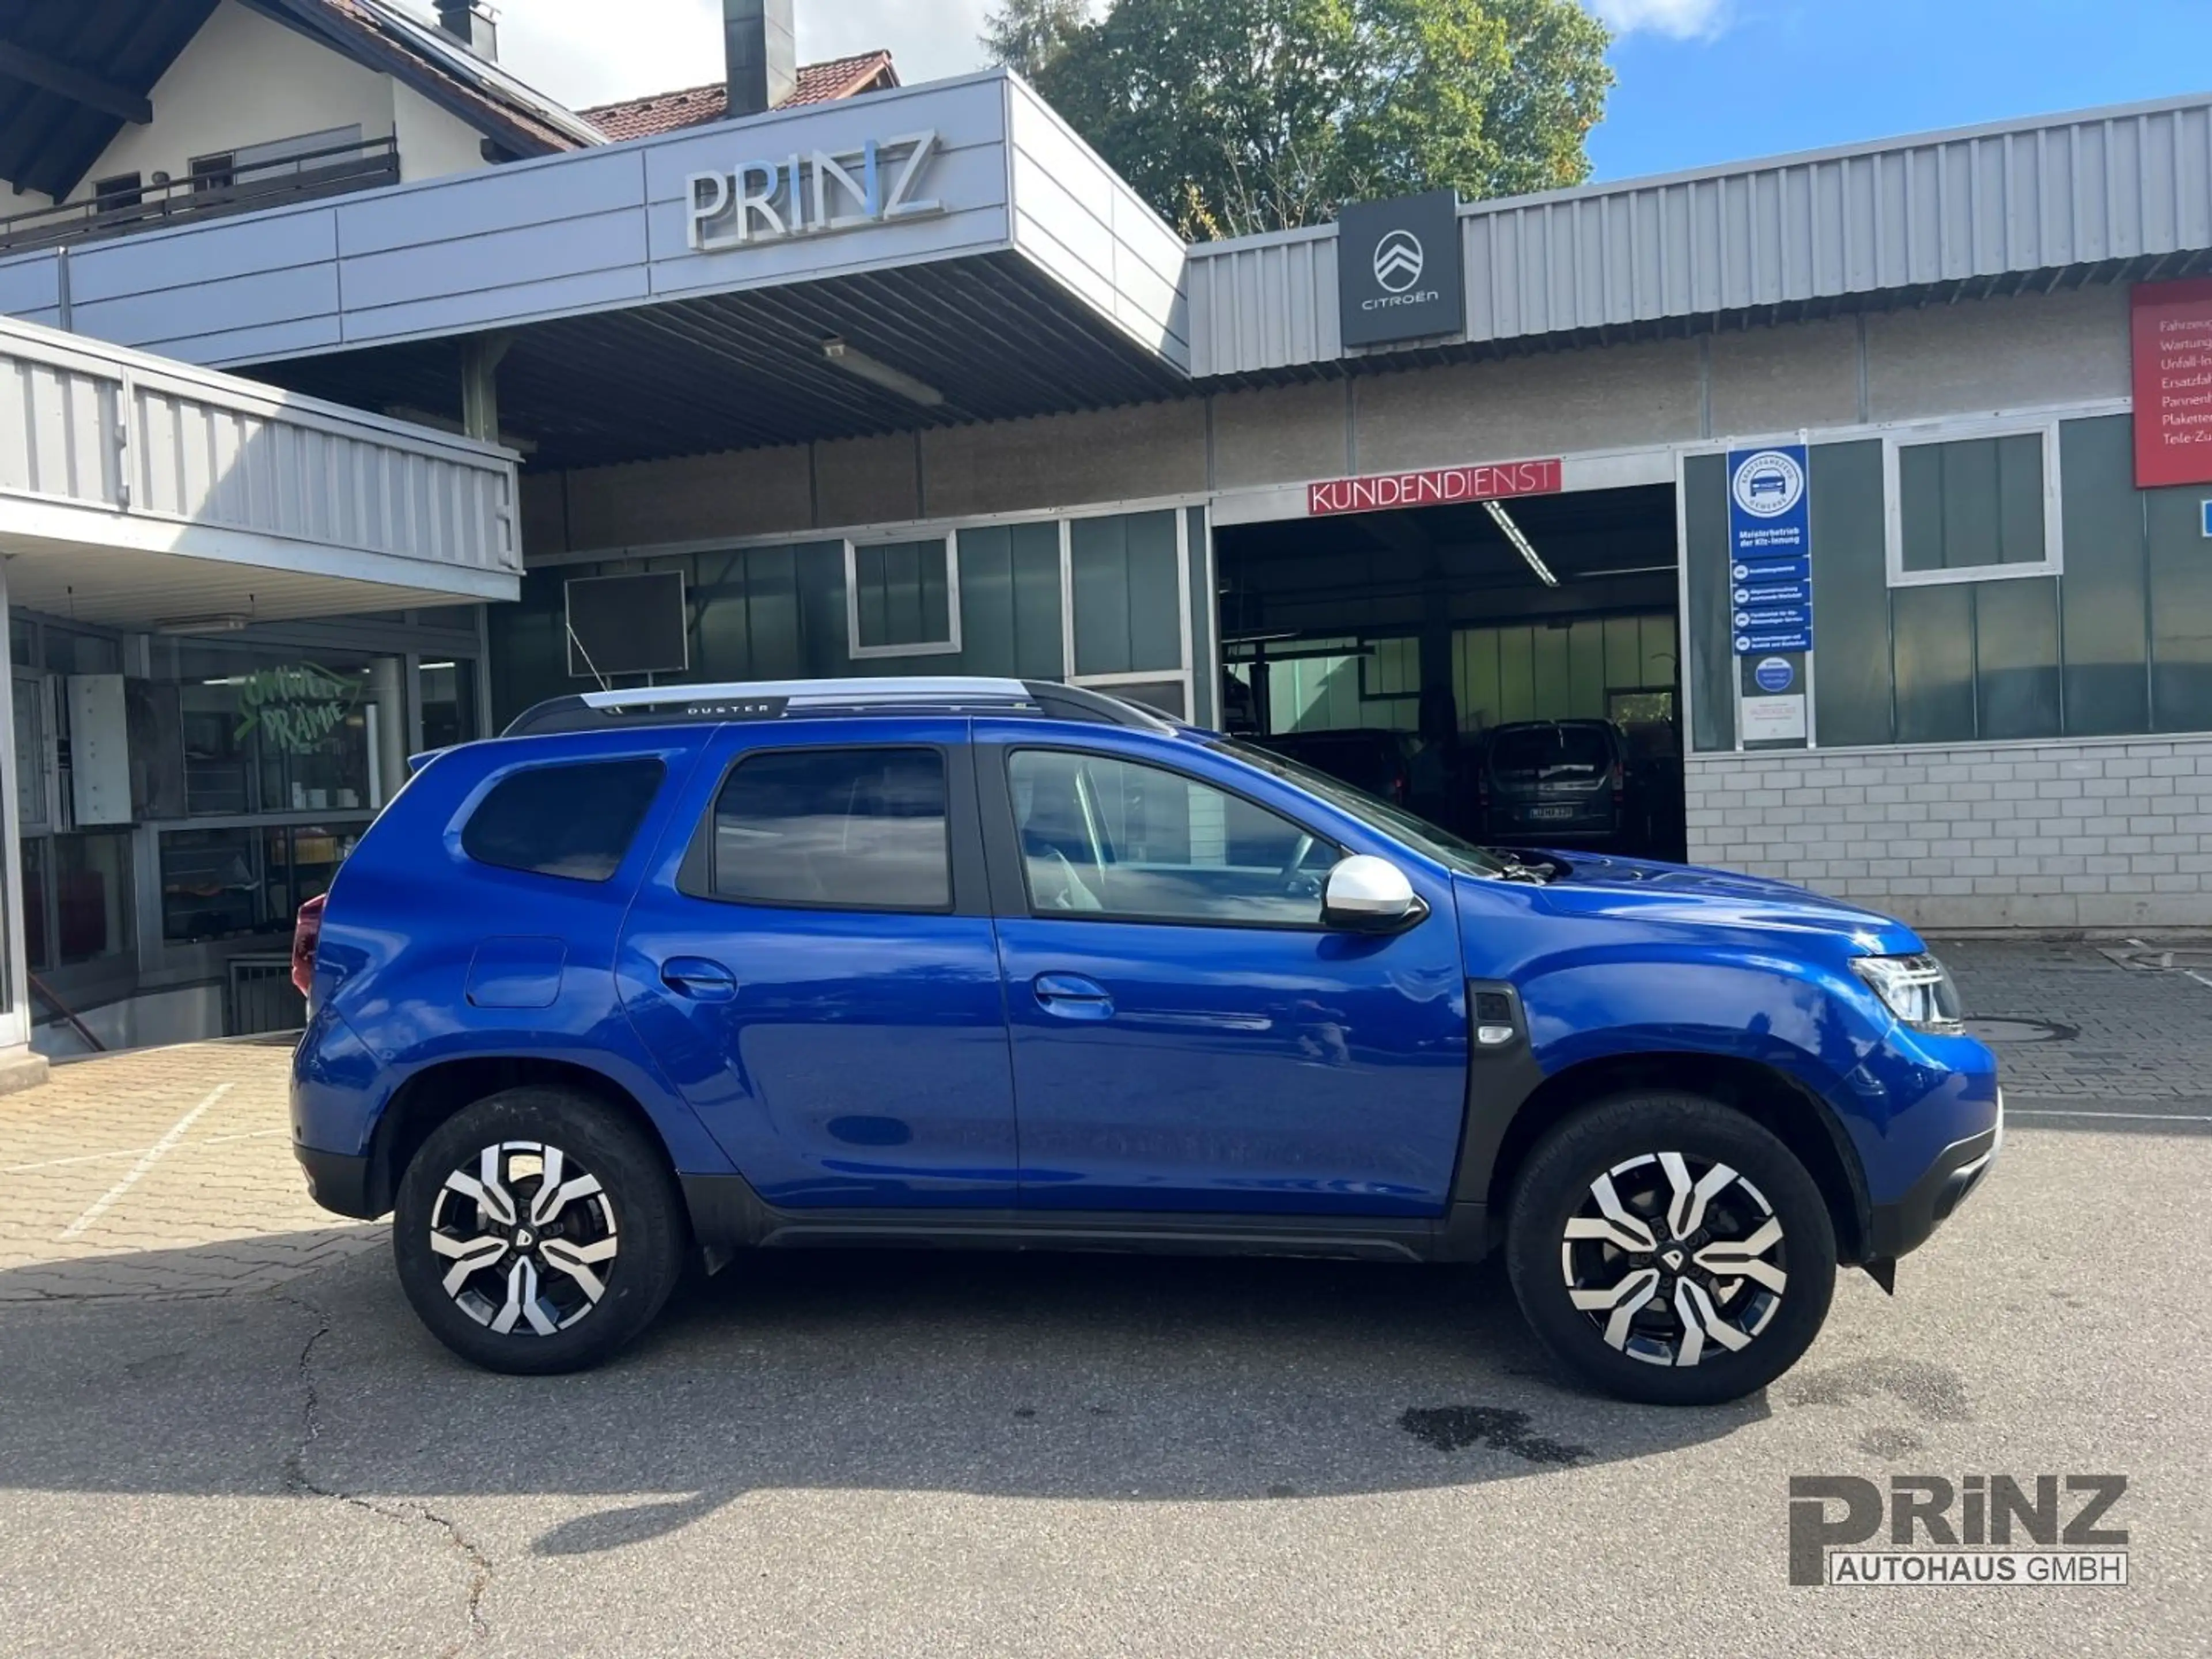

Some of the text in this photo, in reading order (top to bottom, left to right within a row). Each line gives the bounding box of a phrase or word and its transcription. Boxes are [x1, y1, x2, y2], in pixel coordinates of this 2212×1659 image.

[685, 127, 943, 249] PRINZ
[1312, 461, 1555, 512] KUNDENDIENST
[687, 704, 768, 715] DUSTER
